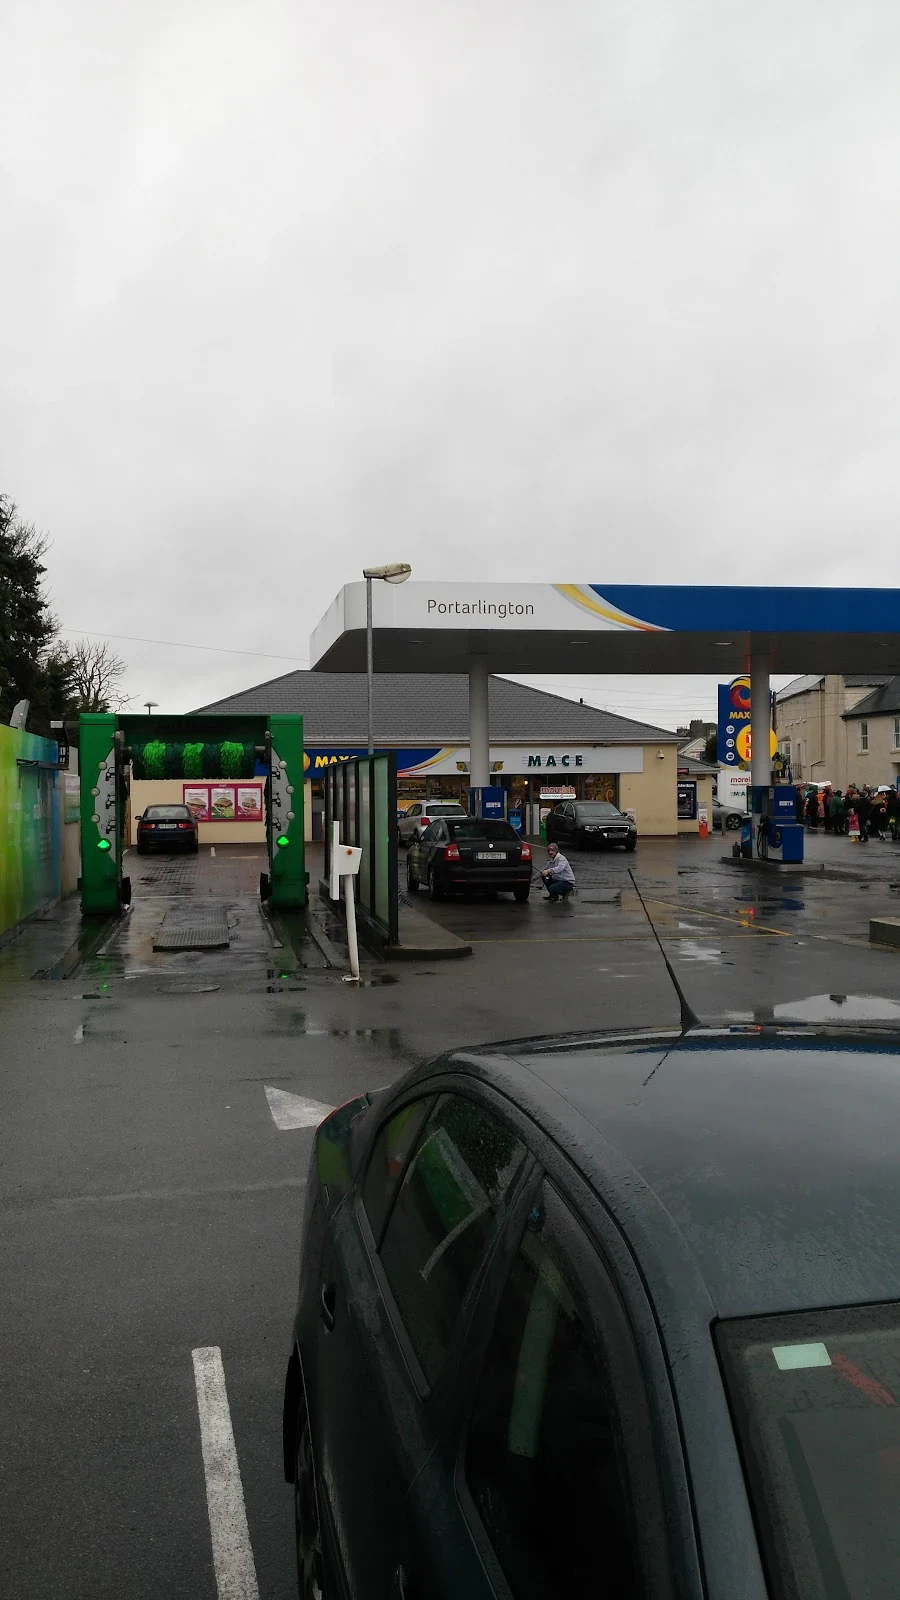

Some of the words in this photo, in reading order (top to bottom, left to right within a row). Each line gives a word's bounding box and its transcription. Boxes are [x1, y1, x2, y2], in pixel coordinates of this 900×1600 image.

[427, 599, 534, 618] Portarlington
[729, 711, 751, 719] MAX
[527, 755, 583, 767] MACE
